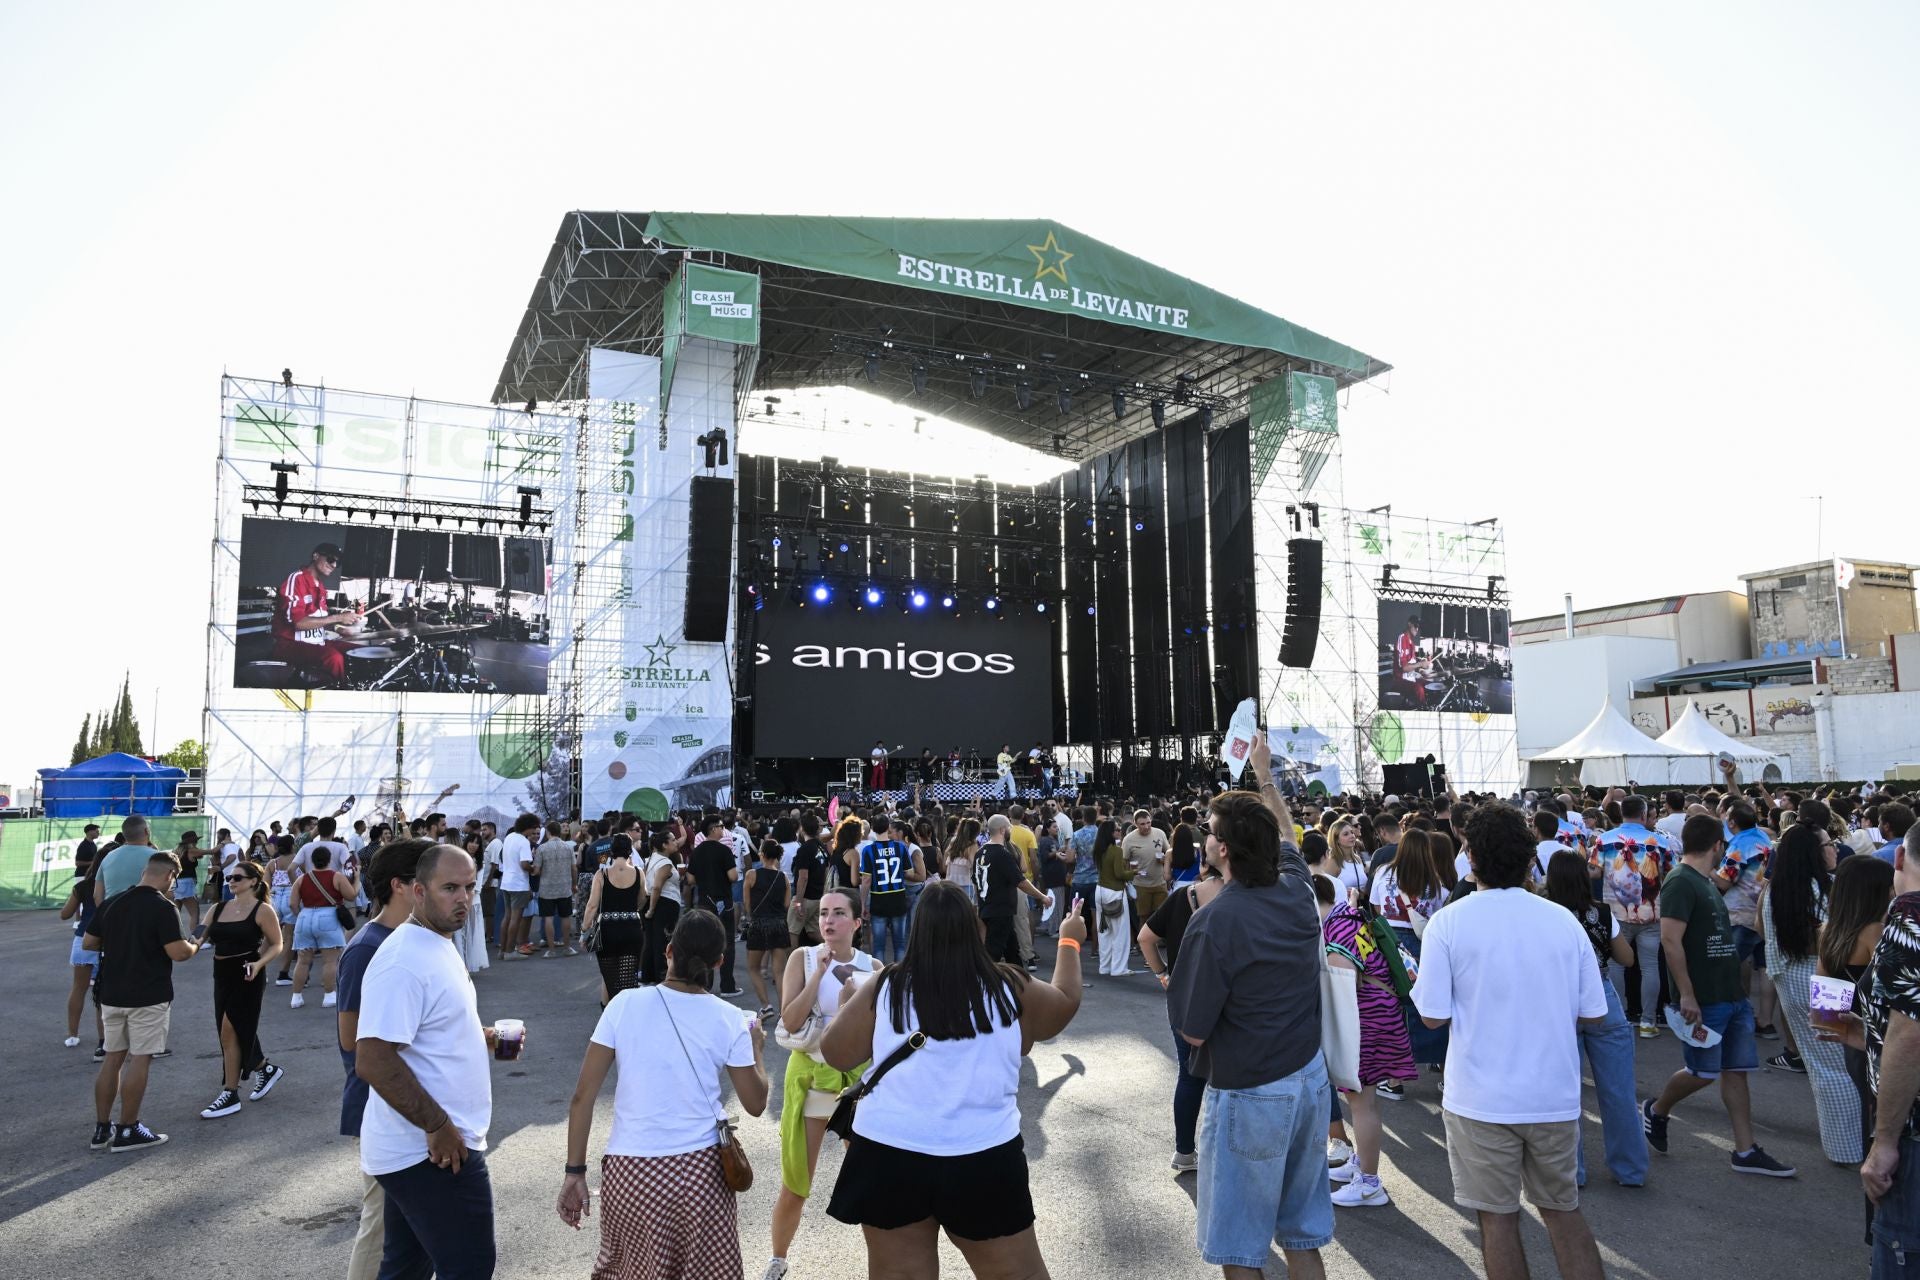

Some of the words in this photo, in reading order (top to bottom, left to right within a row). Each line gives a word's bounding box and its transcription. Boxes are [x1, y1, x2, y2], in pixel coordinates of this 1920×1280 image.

[897, 253, 1049, 302] ESTRELLA
[1049, 288, 1068, 300] DE
[1071, 286, 1189, 329] LEVANTE
[694, 293, 731, 302] CRASH
[714, 306, 748, 316] MUSIC
[792, 642, 1015, 679] amigos
[607, 666, 711, 681] ESTRELLA
[646, 681, 689, 689] LEVANTE
[685, 704, 703, 714] ica
[878, 847, 895, 857] VIERI
[876, 857, 902, 885] 32
